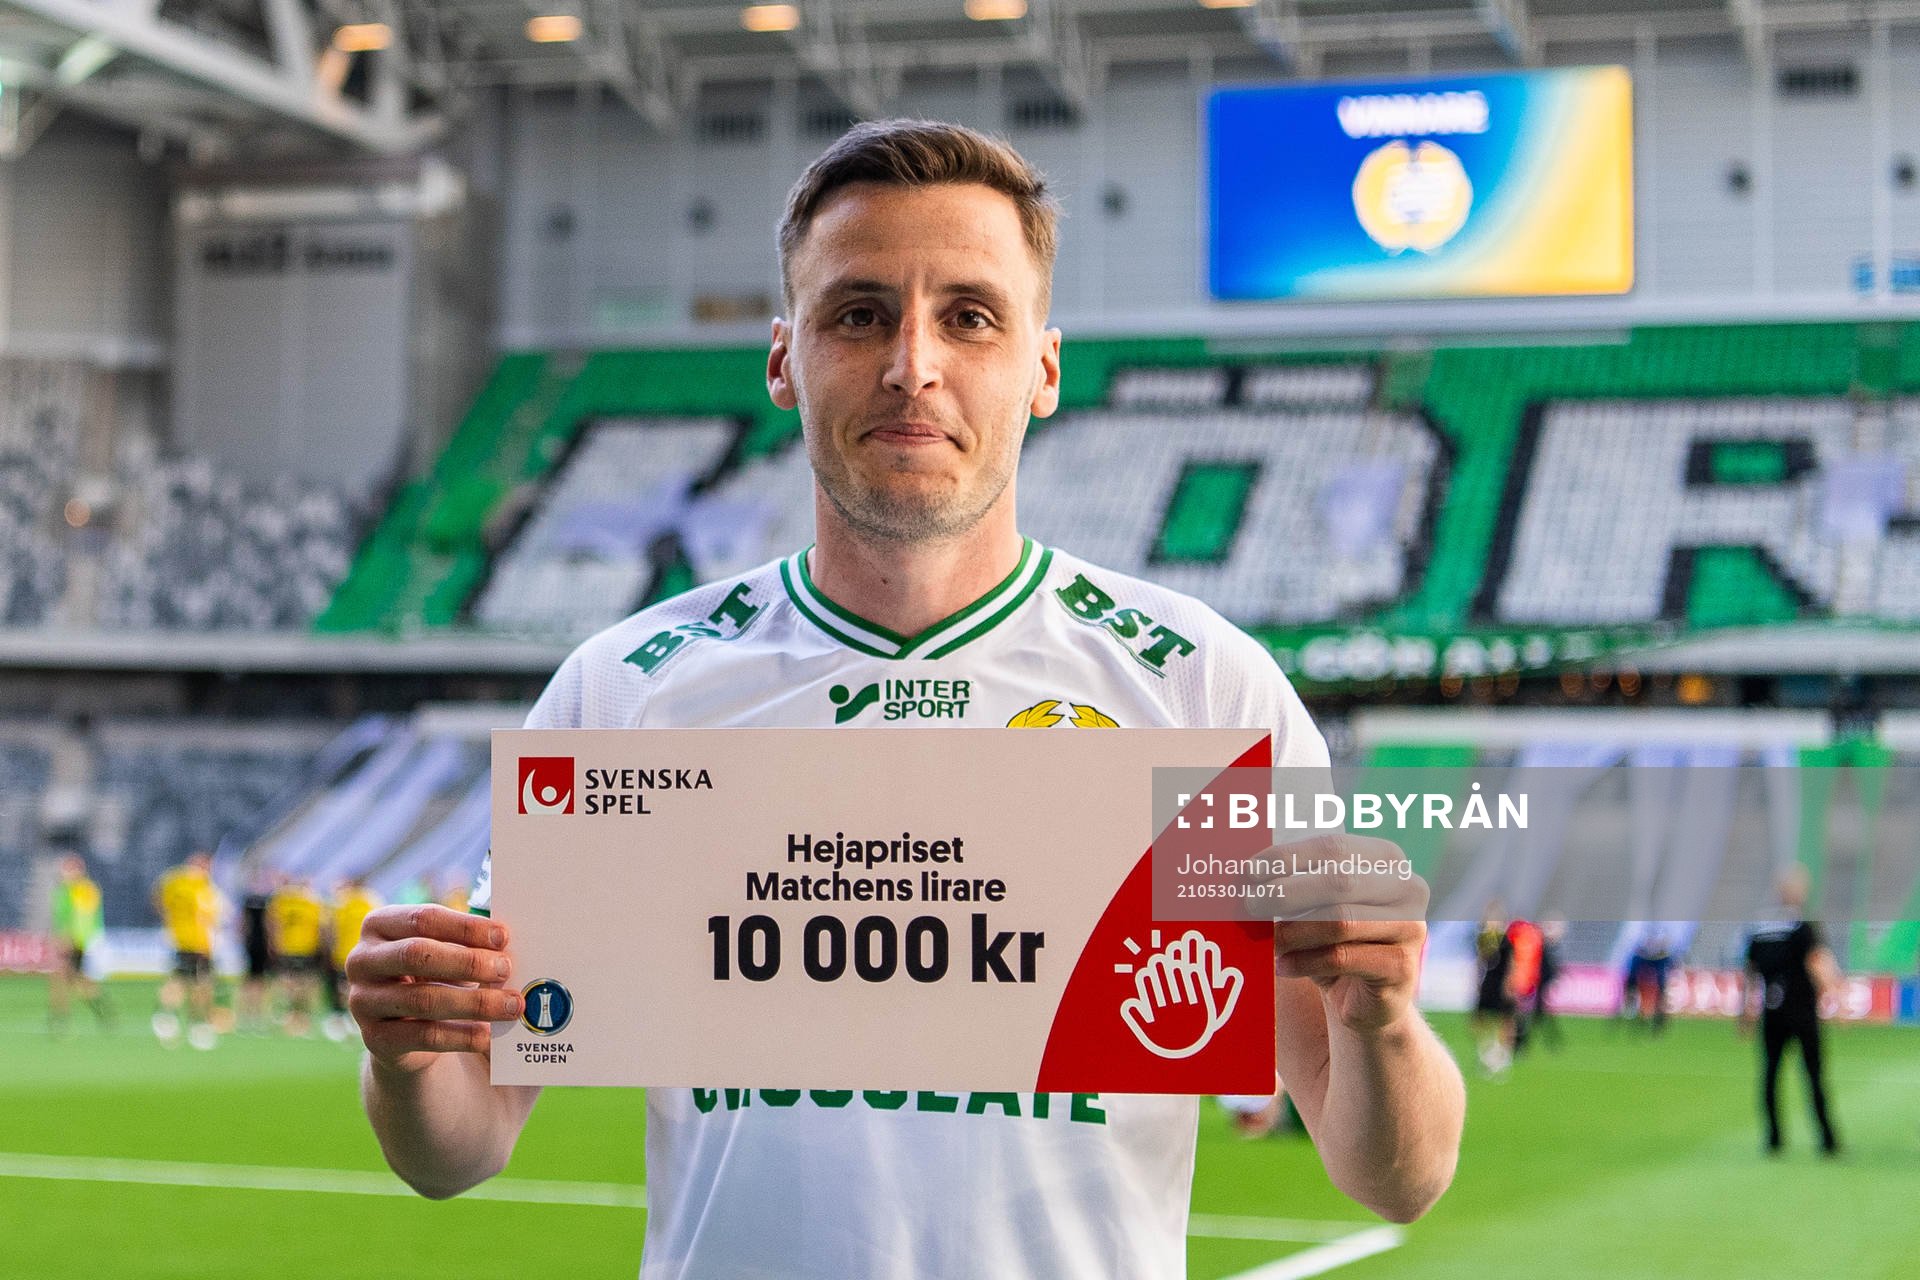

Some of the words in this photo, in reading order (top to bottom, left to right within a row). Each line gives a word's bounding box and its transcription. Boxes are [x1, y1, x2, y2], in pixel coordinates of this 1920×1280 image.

[622, 582, 760, 673] BST
[1055, 573, 1197, 668] BST
[886, 679, 970, 699] INTER
[884, 699, 969, 721] SPORT
[585, 768, 713, 790] SVENSKA
[585, 794, 652, 815] SPEL
[787, 831, 964, 868] Hejapriset
[746, 868, 914, 902] Matchens
[921, 869, 1007, 902] lirare
[708, 914, 781, 982] 10
[803, 914, 949, 984] 000
[971, 913, 1045, 983] kr
[516, 1042, 575, 1053] SVENSKA
[524, 1053, 567, 1064] CUPEN
